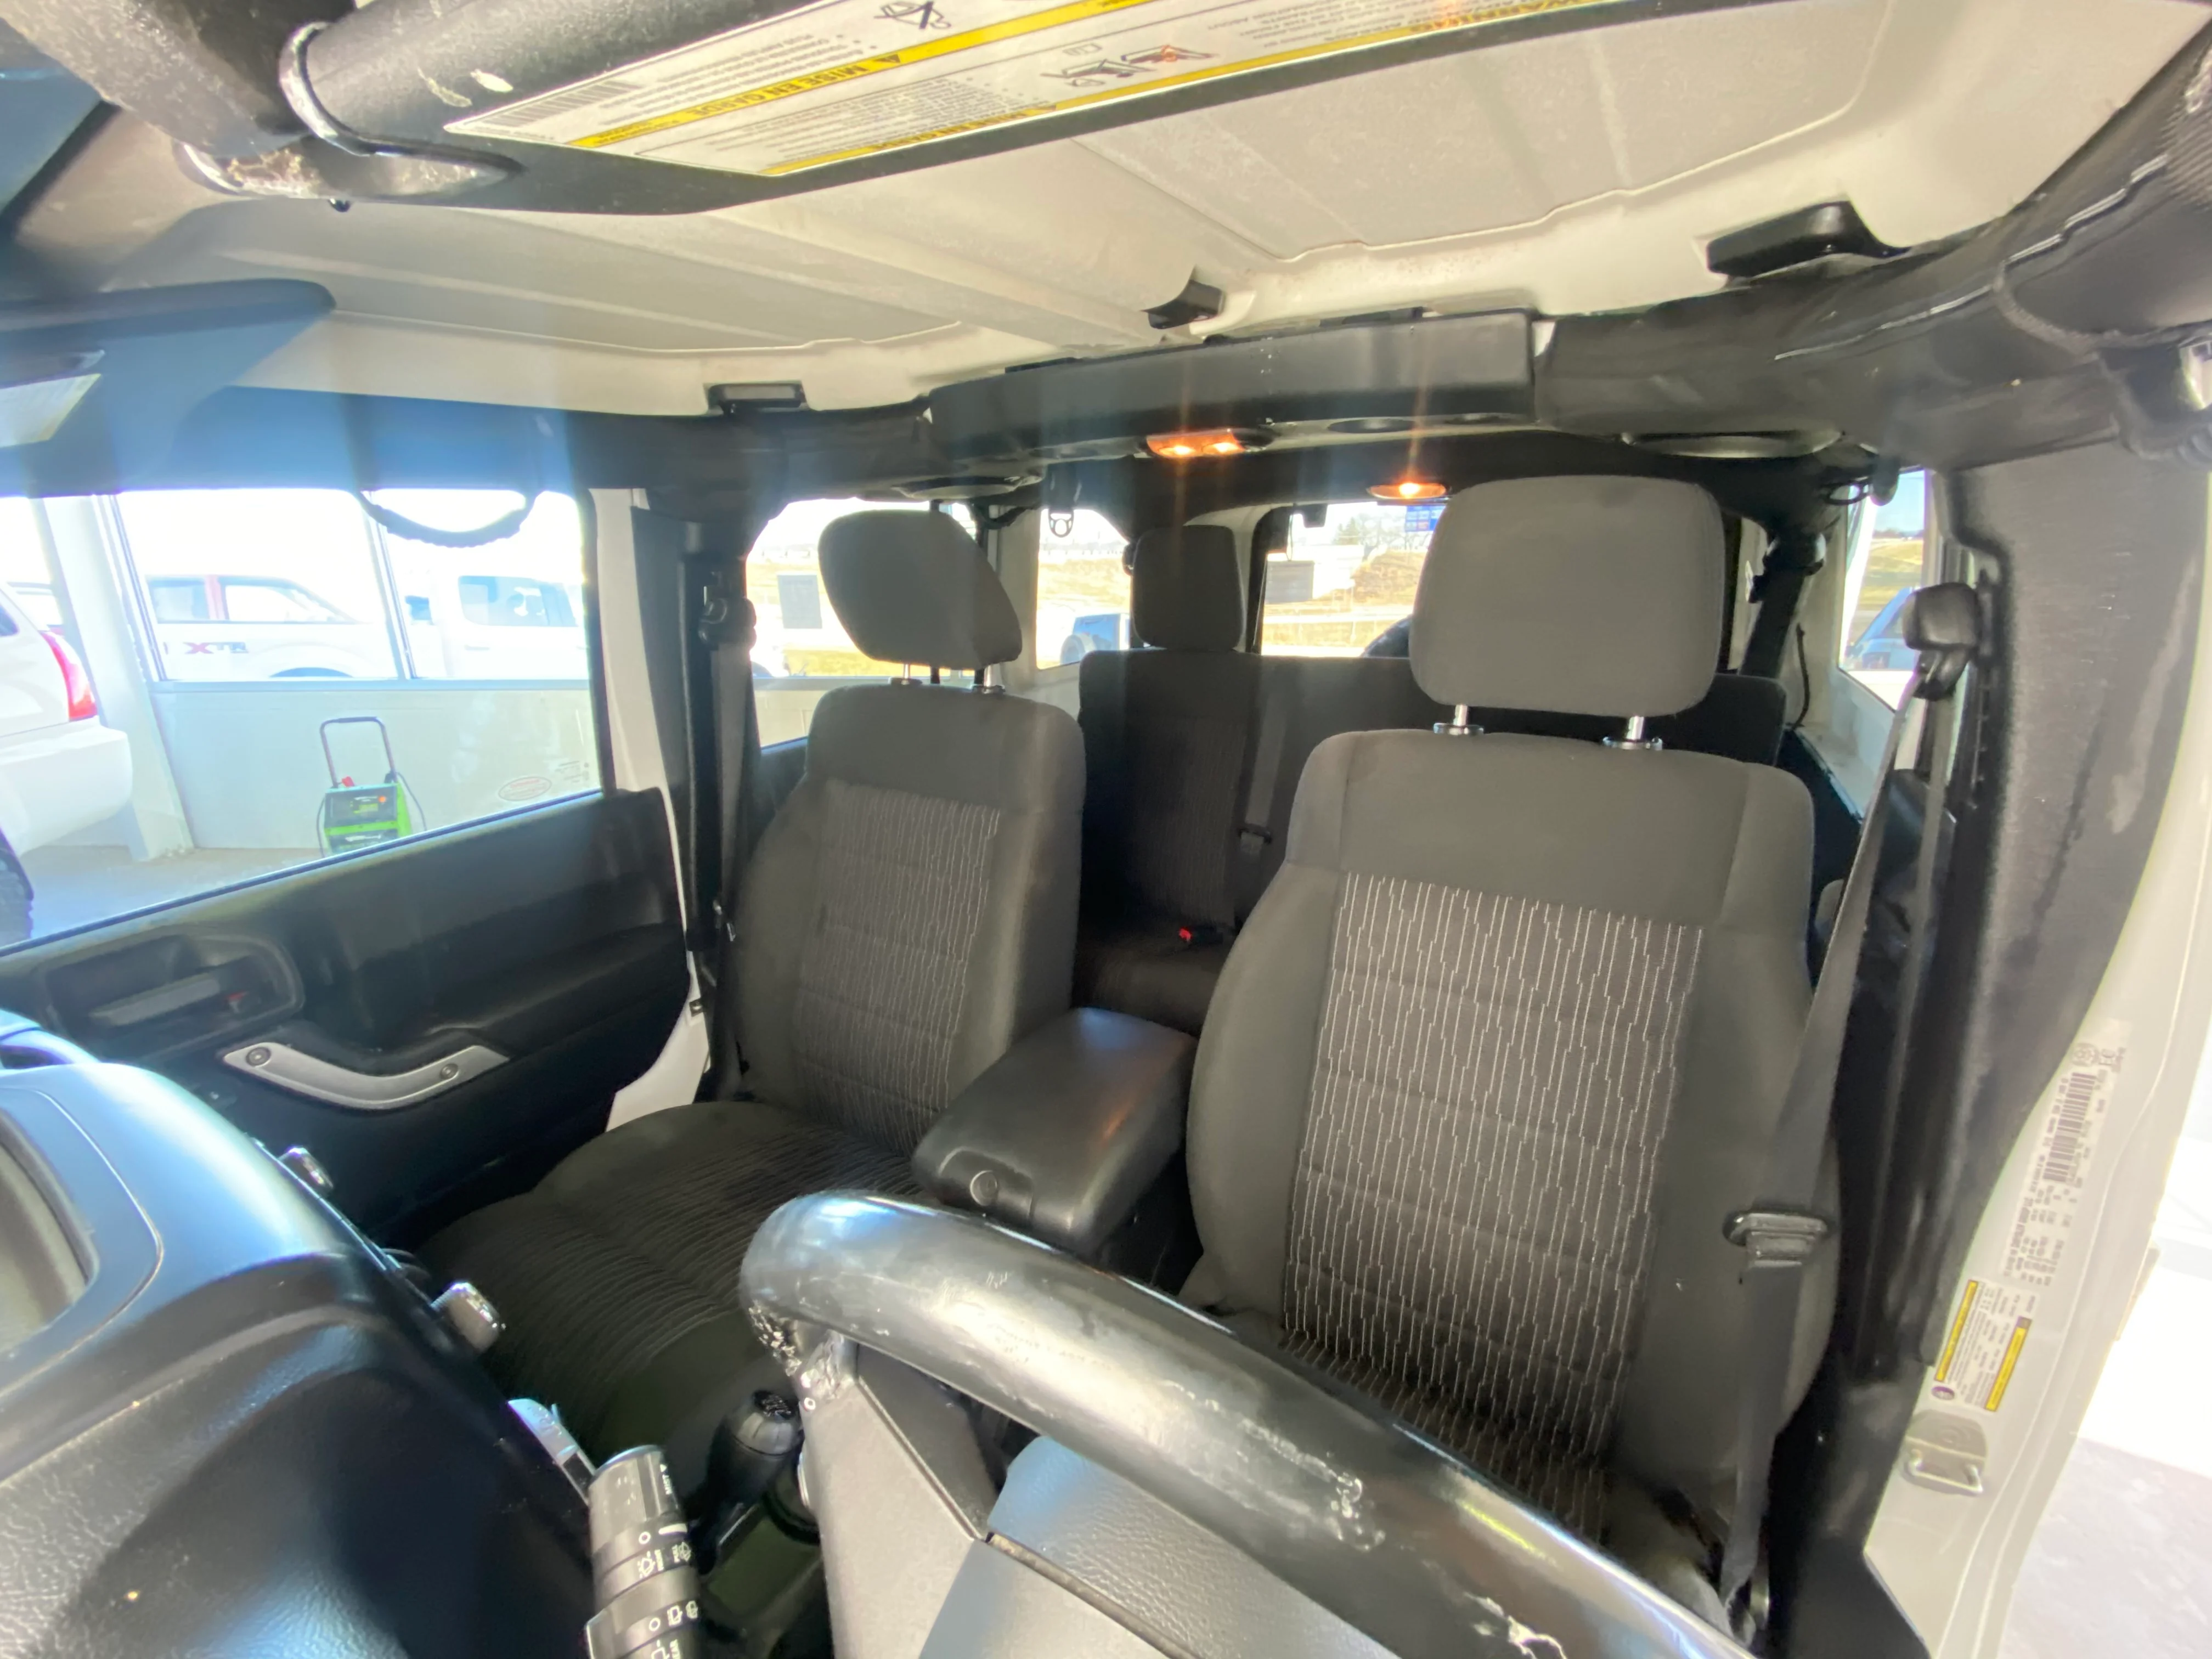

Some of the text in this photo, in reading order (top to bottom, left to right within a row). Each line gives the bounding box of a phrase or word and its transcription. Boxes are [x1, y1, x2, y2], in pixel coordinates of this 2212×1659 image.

[799, 65, 868, 86] MISE
[766, 83, 803, 96] EN
[686, 93, 766, 116] GARDE
